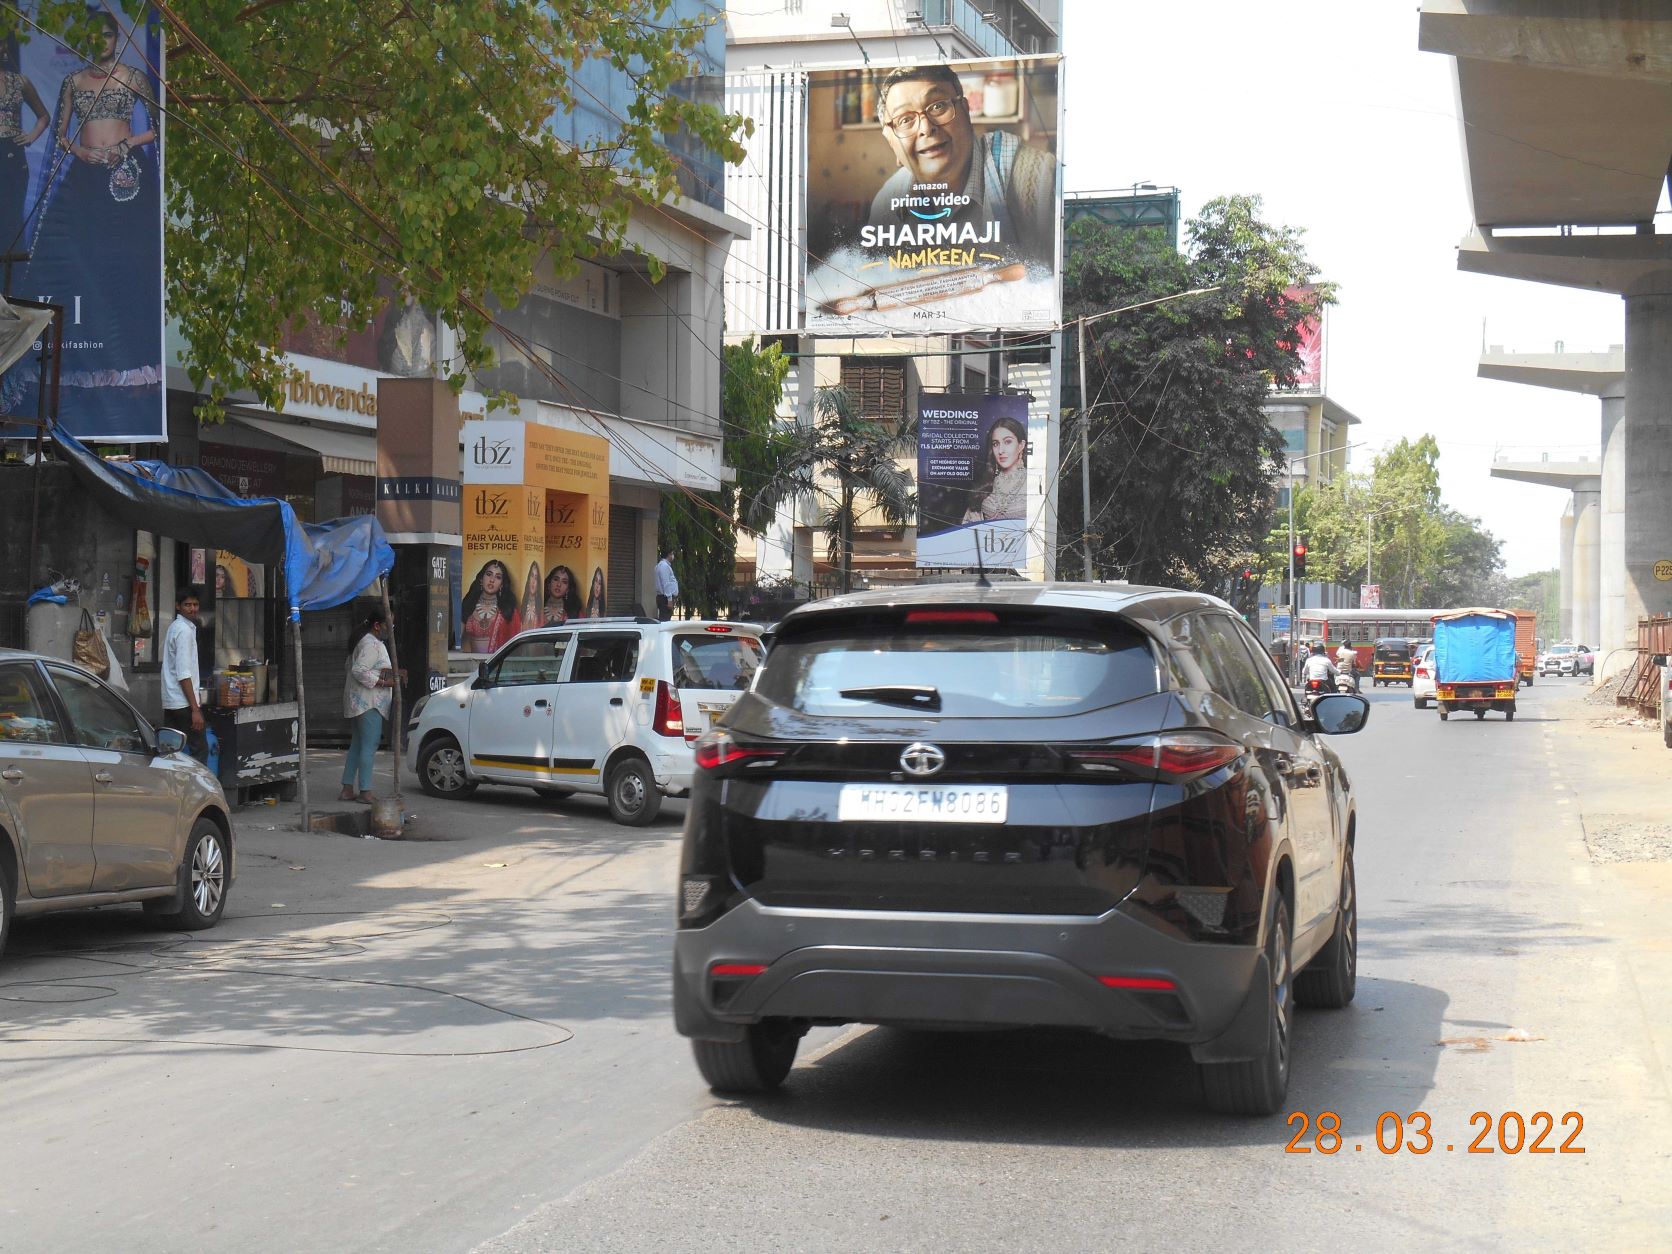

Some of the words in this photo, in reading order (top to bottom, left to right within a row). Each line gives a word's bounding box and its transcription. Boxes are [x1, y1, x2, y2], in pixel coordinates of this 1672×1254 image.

[913, 183, 948, 191] amazon
[891, 194, 930, 210] prime
[932, 192, 970, 207] video
[860, 221, 1000, 248] SHARMAJI
[888, 247, 976, 272] NAMKEEN
[913, 311, 934, 319] MAR
[936, 311, 946, 319] 31
[922, 410, 979, 419] WEDDINGS
[473, 436, 512, 465] tbz
[475, 490, 508, 515] tbz
[466, 534, 487, 542] FAIR
[488, 534, 520, 543] VALUE,
[467, 542, 490, 551] BEST
[491, 542, 518, 551] PRICE
[431, 556, 447, 569] GATE
[430, 676, 446, 691] GATE
